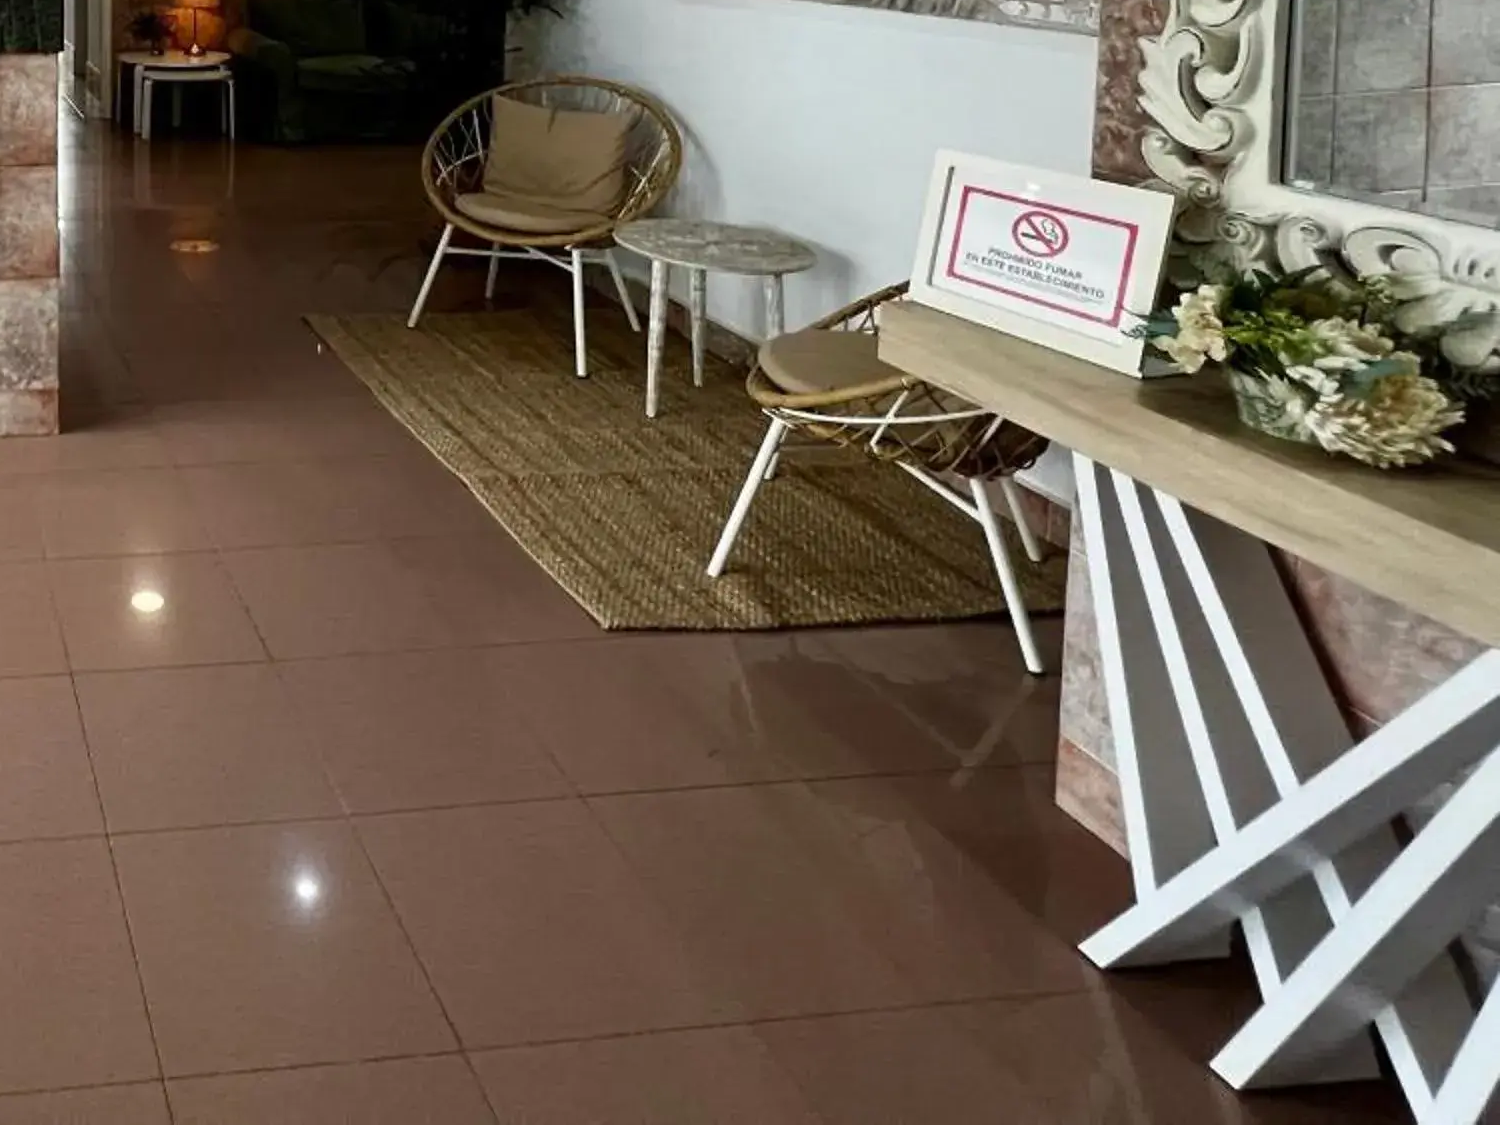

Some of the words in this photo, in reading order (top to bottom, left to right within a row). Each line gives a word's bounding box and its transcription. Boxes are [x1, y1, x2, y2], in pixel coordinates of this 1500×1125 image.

[965, 251, 979, 264] EN
[981, 256, 1006, 270] ESTE
[1007, 264, 1105, 299] ESTABLECIMIENTO
[988, 247, 1043, 269] PROHIBIDO
[1045, 262, 1083, 279] FUMAR
